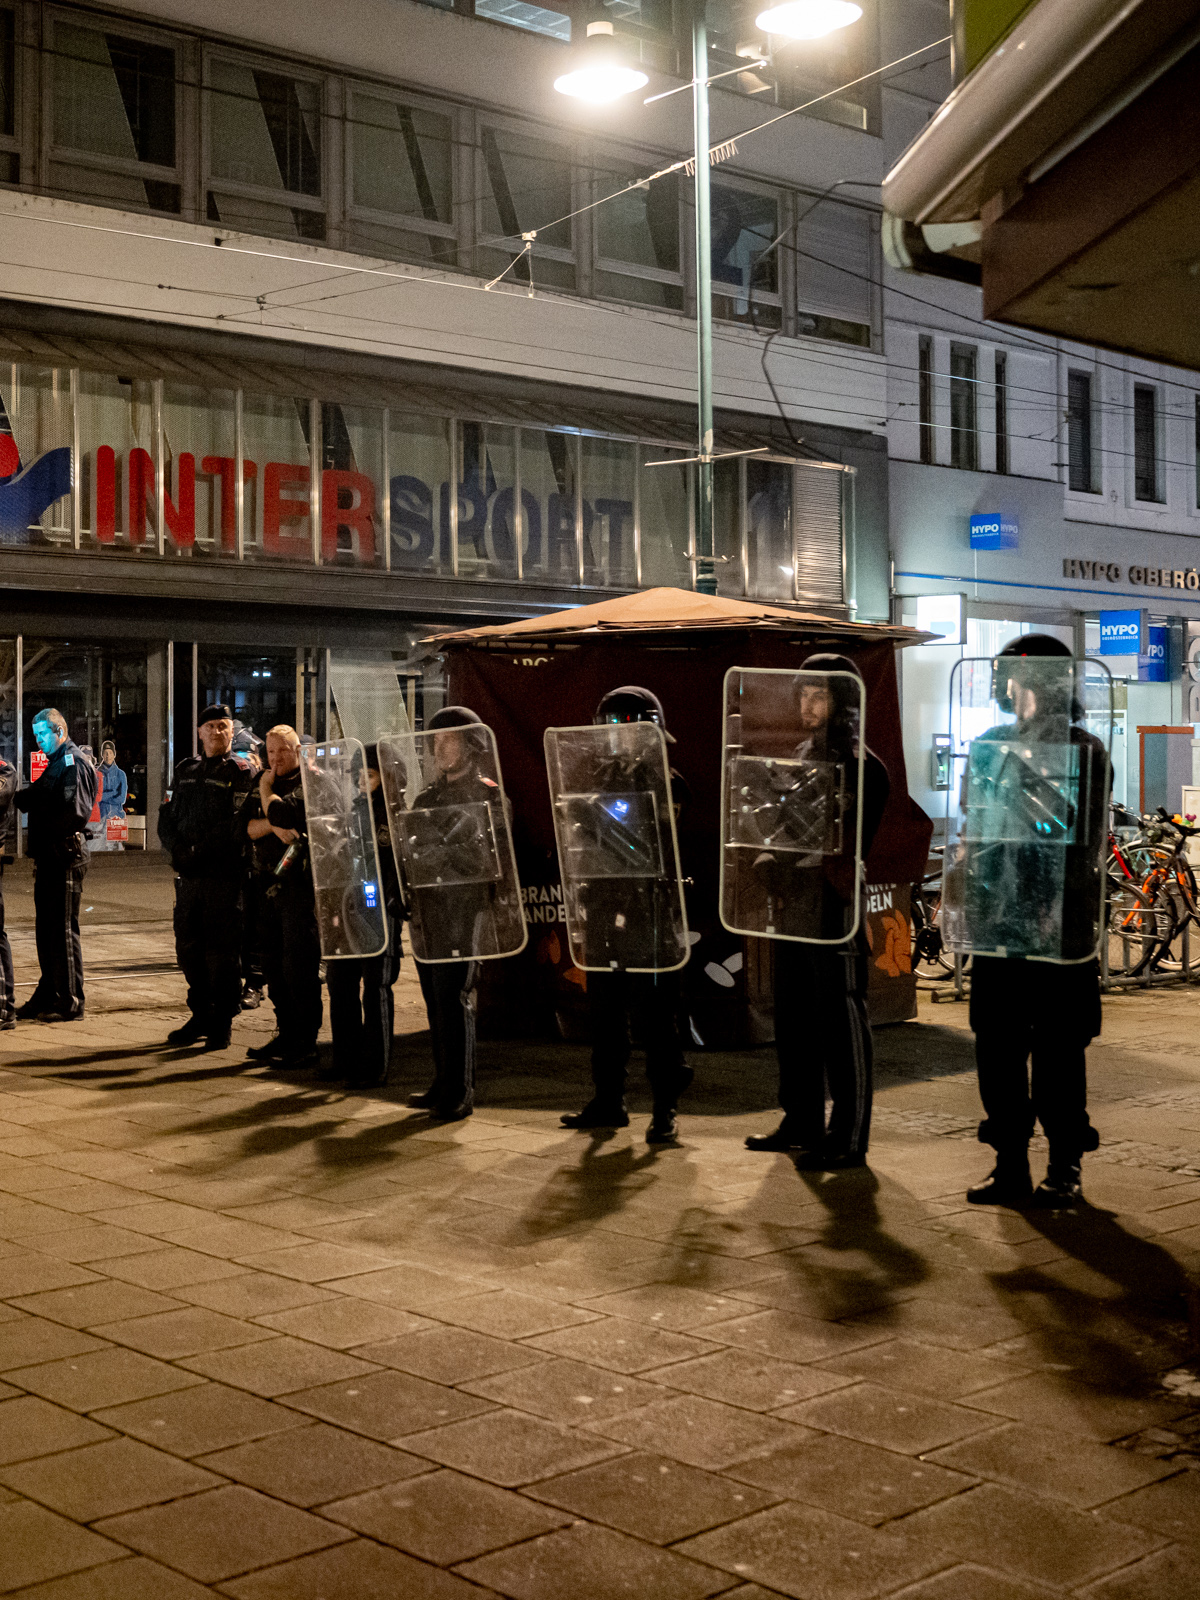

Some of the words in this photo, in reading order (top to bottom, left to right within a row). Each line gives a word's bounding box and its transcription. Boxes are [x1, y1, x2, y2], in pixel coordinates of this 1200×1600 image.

[96, 444, 633, 575] INTERSPORT
[972, 524, 999, 534] HYPO
[1063, 558, 1120, 583] HYPO
[1128, 565, 1200, 591] OBERÖ
[1101, 624, 1139, 636] HYPO
